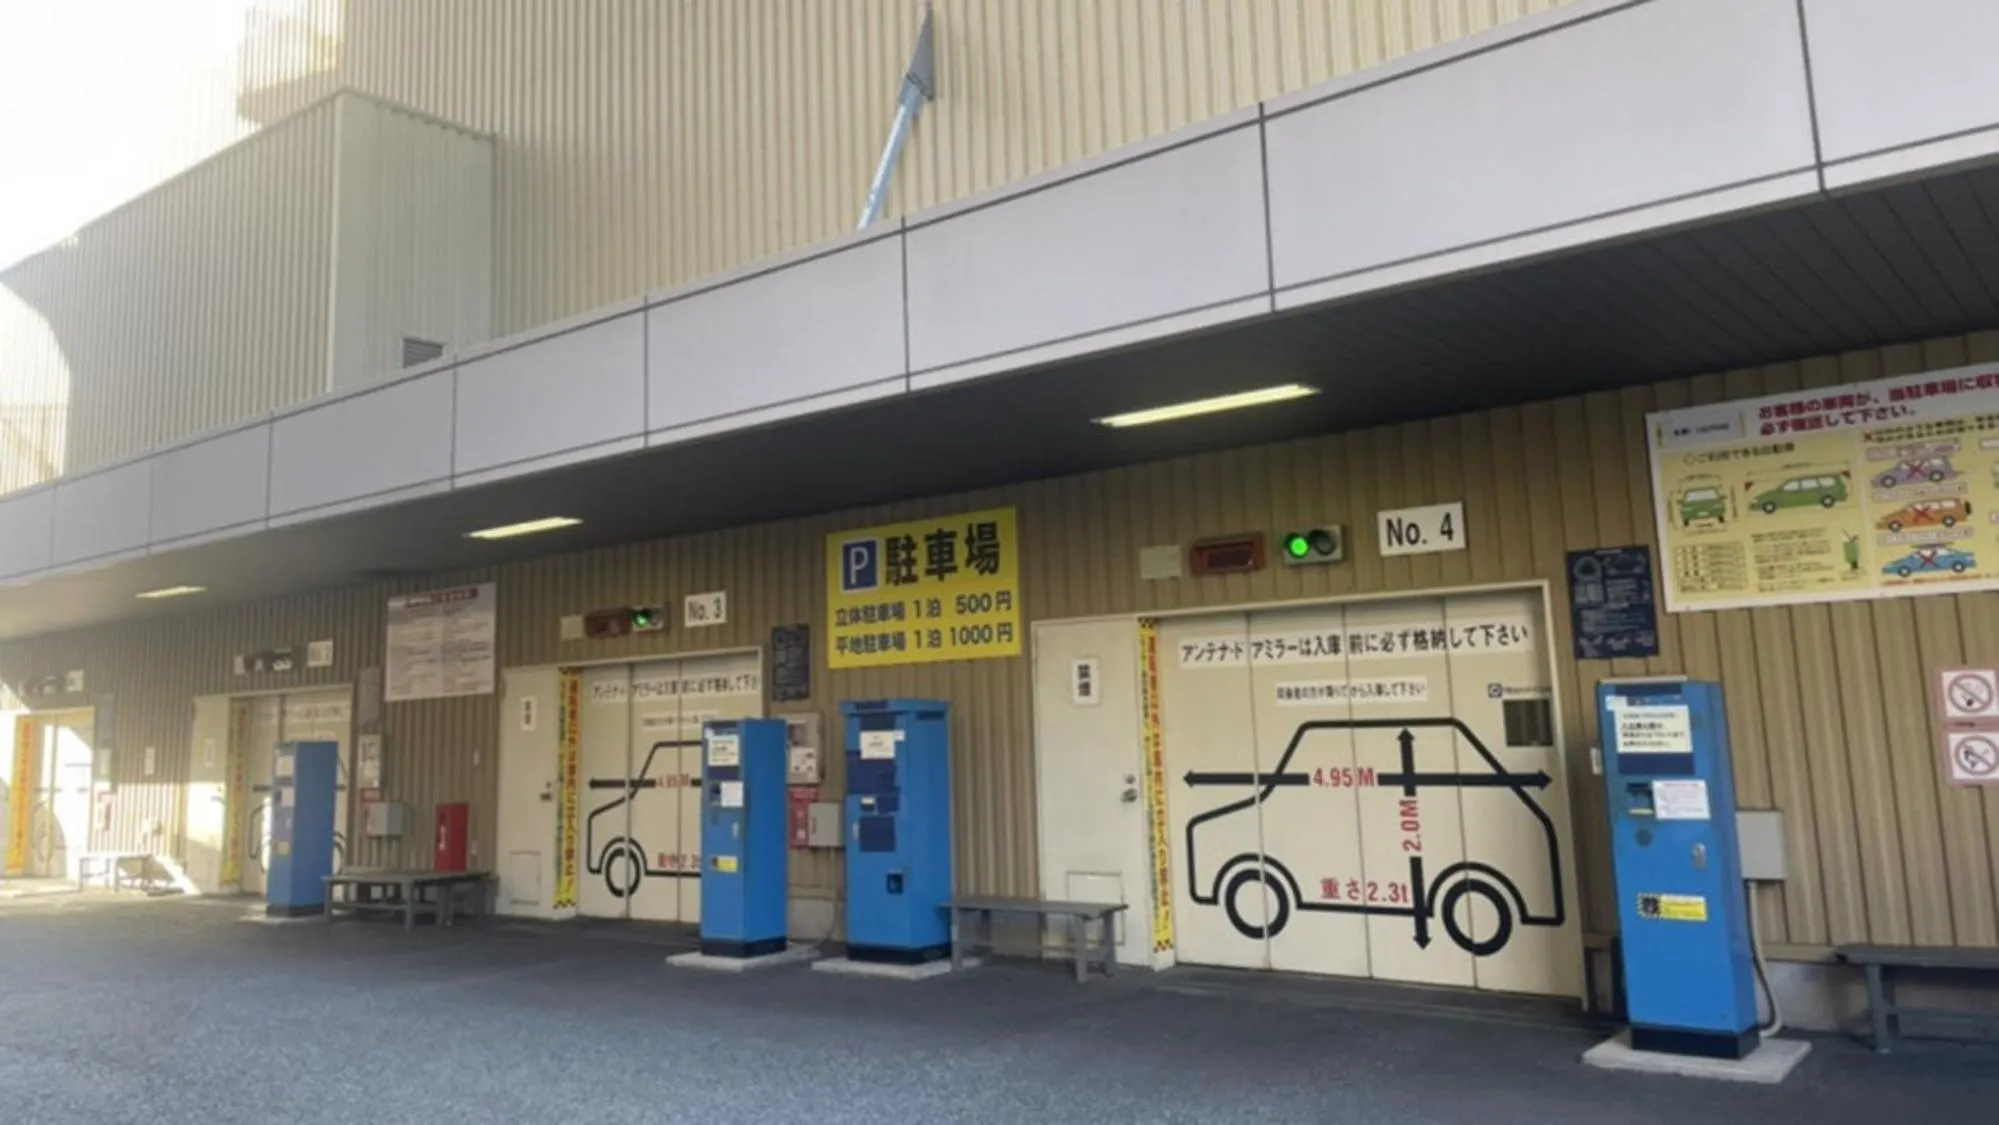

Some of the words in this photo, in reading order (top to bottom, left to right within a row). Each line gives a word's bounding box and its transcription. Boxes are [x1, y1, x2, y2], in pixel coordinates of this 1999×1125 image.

[1386, 517, 1428, 547] No.
[1440, 512, 1455, 542] 4
[850, 547, 869, 585] P
[885, 521, 1001, 587] 駐車場
[689, 601, 710, 622] No.
[835, 600, 906, 627] 立体駐車場
[955, 590, 1013, 616] 500円
[835, 631, 907, 655] 平地駐車場
[949, 622, 1013, 647] 1000円
[1399, 799, 1422, 852] 2.0M
